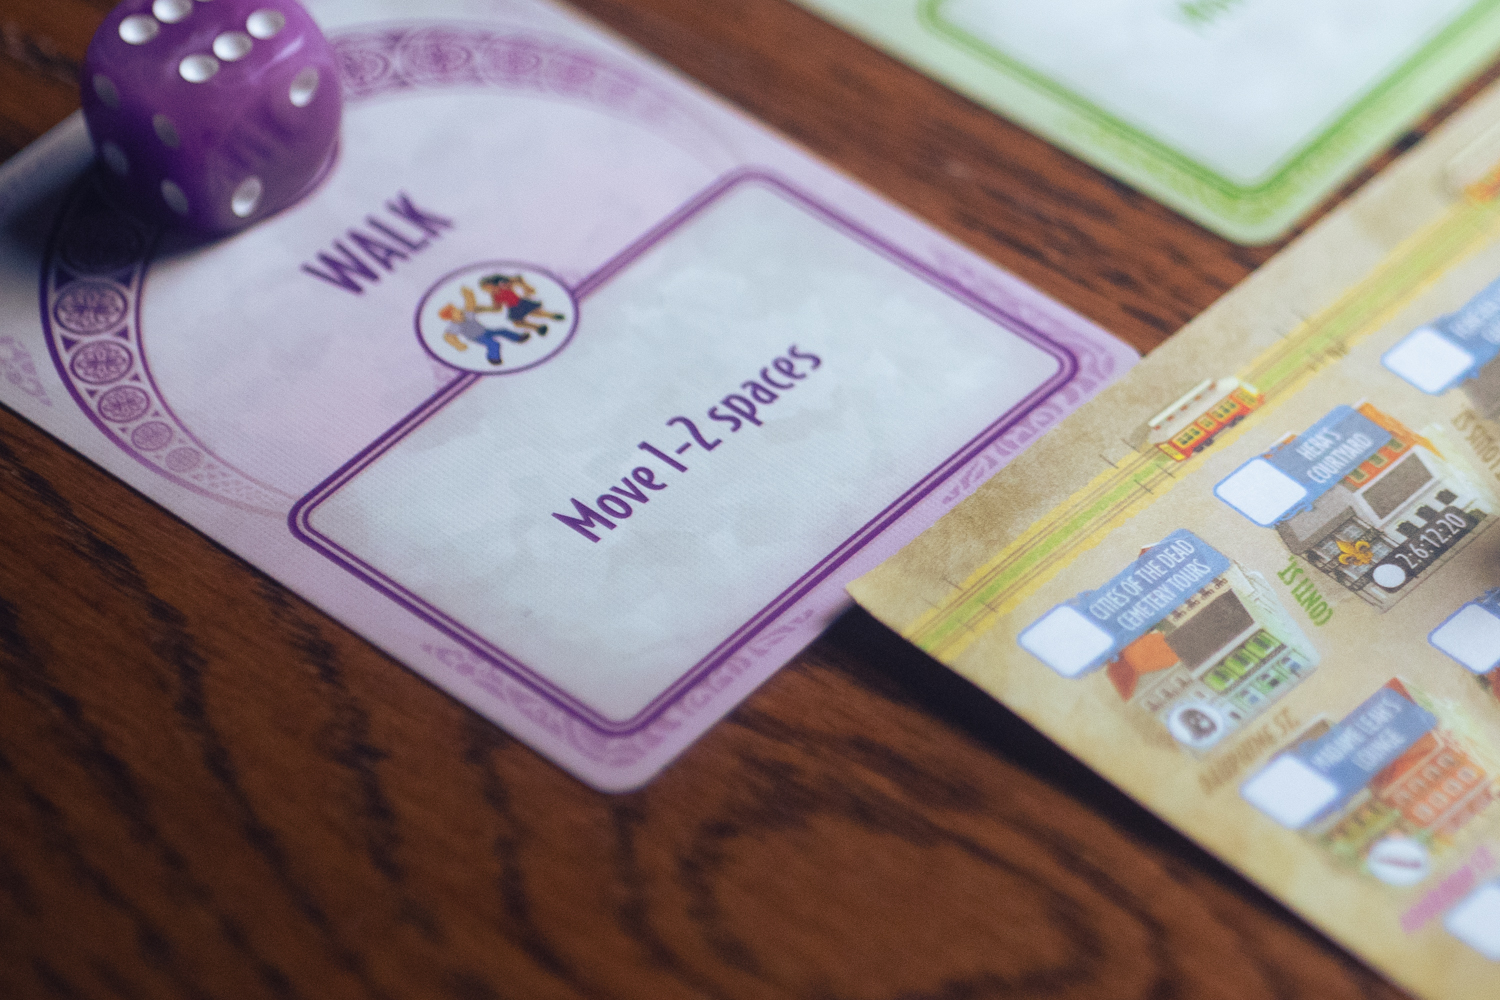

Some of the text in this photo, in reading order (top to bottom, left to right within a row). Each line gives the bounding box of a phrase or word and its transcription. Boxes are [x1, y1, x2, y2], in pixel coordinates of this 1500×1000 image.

[300, 190, 453, 295] WALK
[551, 344, 822, 543] Move 1-2 spaces
[1307, 432, 1374, 484] COURTYARD
[1089, 539, 1195, 620] CITIES OF THE DEAD
[1116, 558, 1211, 631] CEMETERY TOURS
[1291, 577, 1334, 627] CONTI
